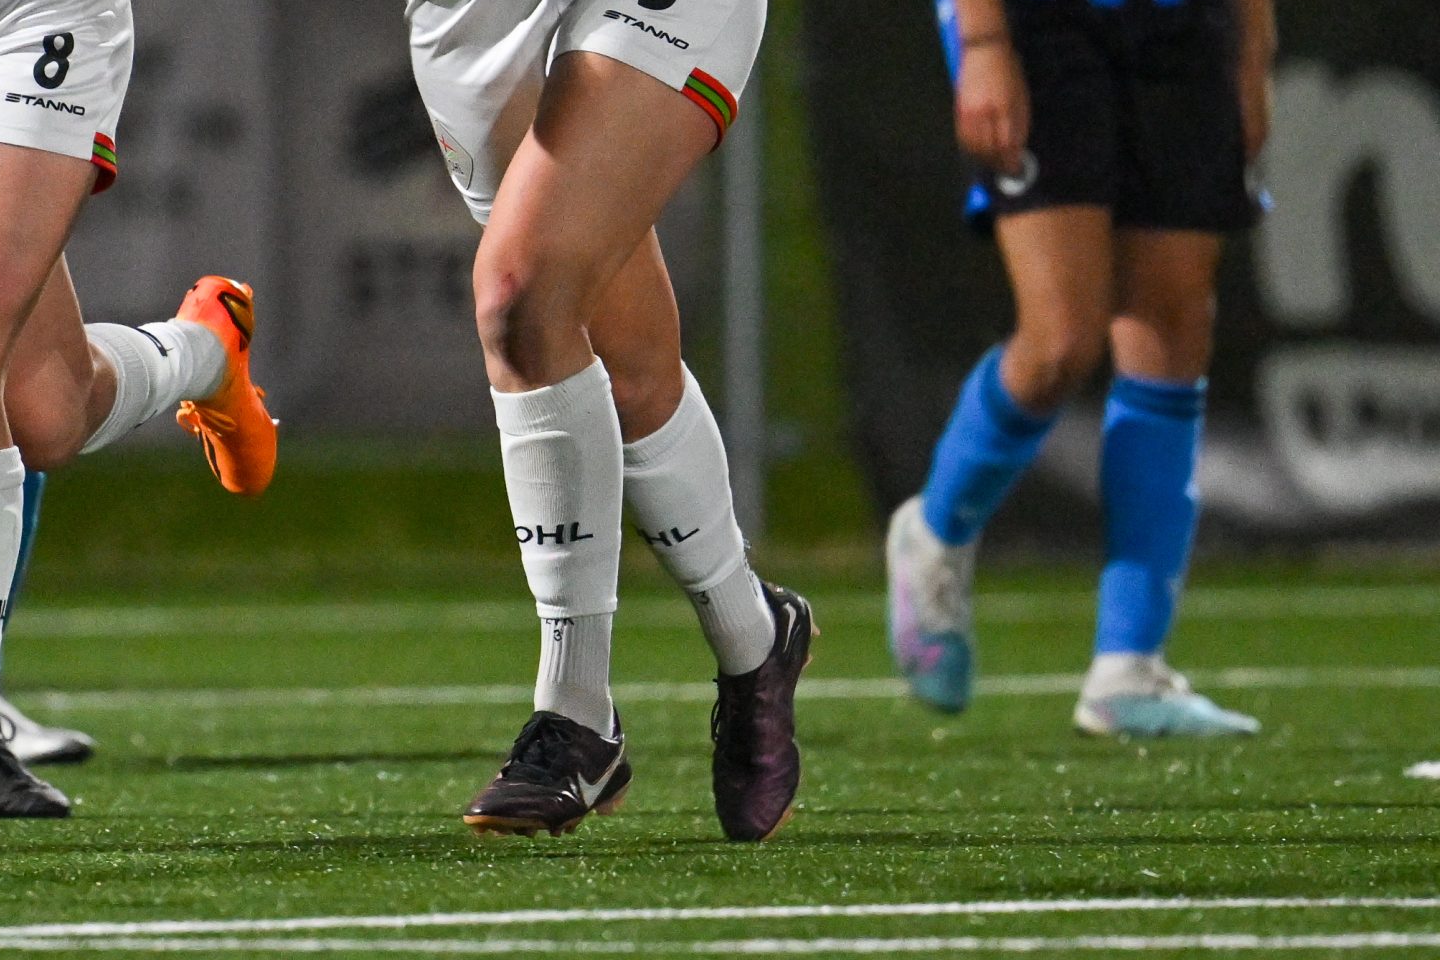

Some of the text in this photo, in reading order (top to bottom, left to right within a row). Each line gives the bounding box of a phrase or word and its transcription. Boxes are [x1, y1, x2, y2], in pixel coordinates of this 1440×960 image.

[603, 10, 689, 49] STANNO
[33, 32, 74, 89] 8
[5, 93, 85, 116] STANNO
[515, 522, 594, 545] OHL
[636, 526, 700, 547] HL
